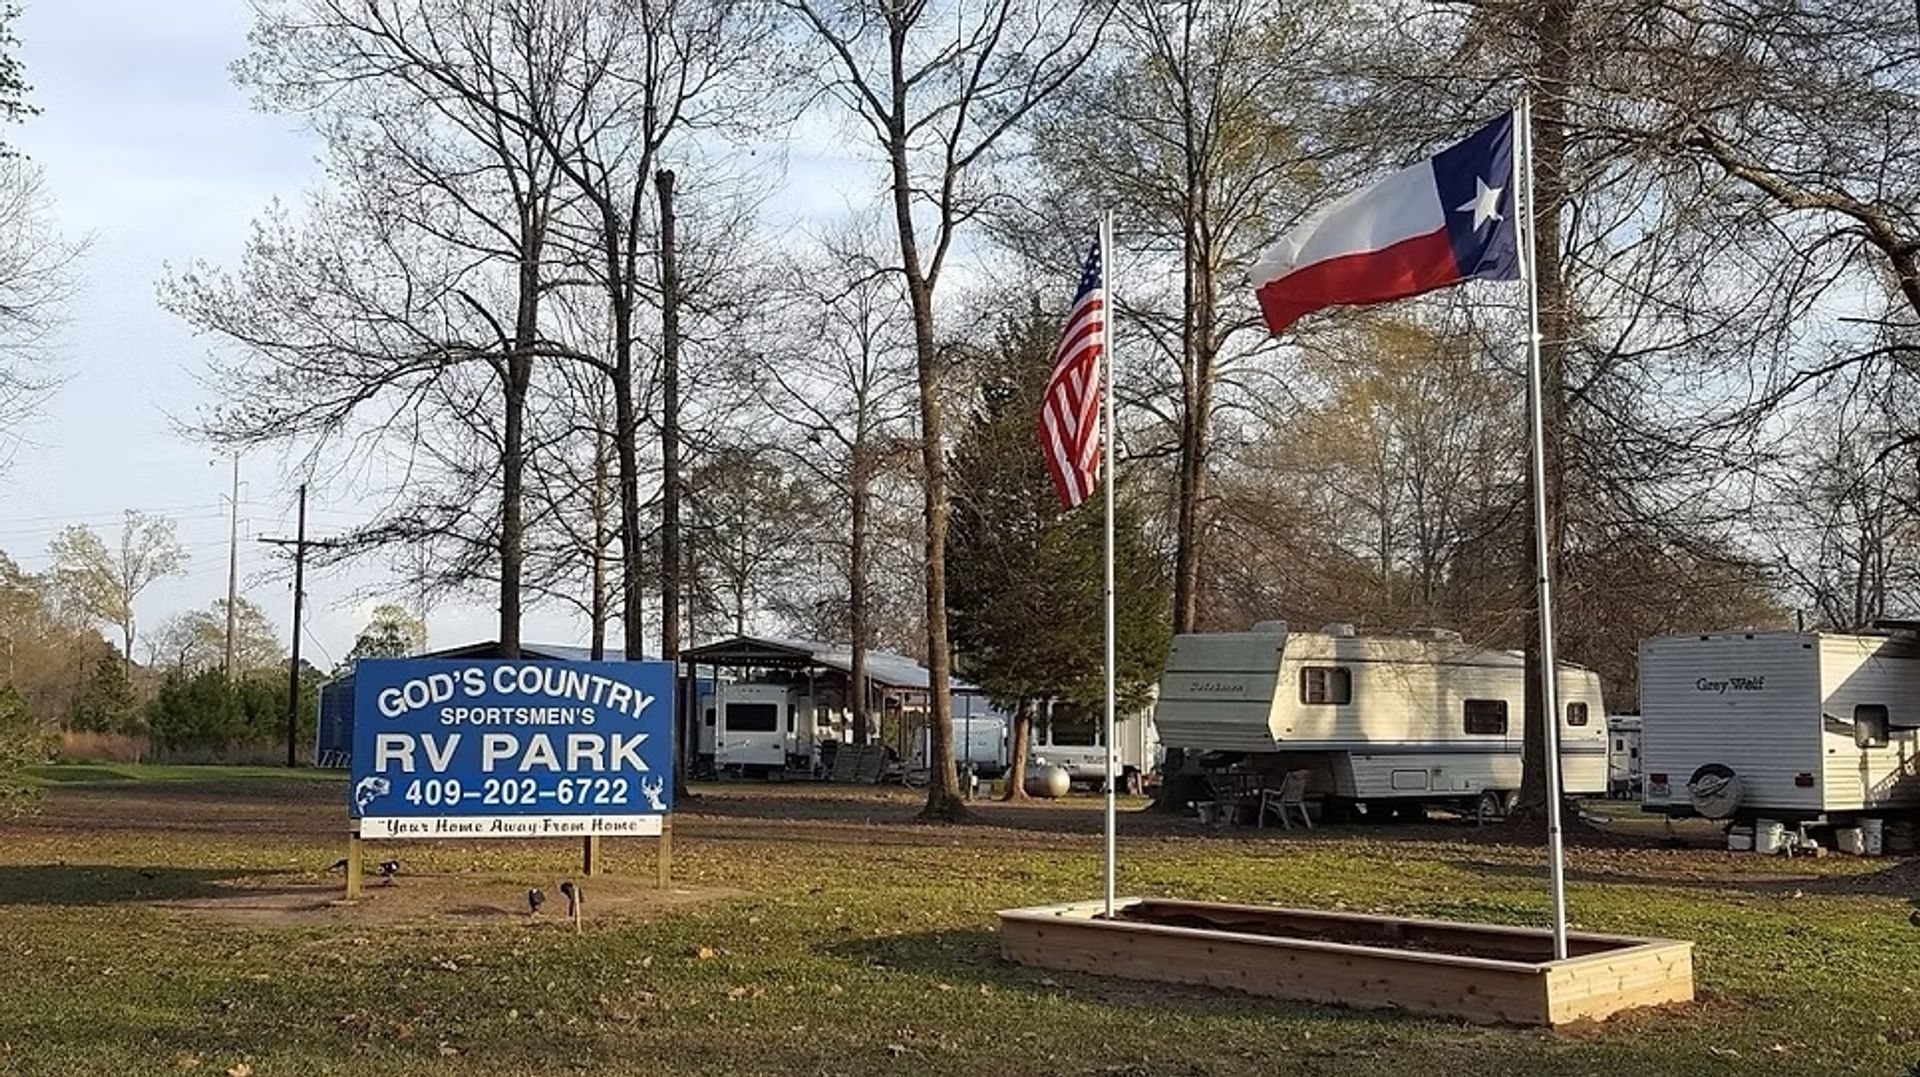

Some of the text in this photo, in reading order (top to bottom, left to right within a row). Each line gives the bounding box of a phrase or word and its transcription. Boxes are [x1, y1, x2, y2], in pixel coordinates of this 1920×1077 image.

[378, 666, 655, 720] GOD'S COUNTRY
[1729, 676, 1765, 690] Wolf
[440, 707, 596, 725] SPORTSMEN'S
[374, 732, 650, 773] RV PARK
[405, 778, 629, 806] 409-202-6722
[435, 818, 484, 833] Home
[542, 817, 584, 833] From
